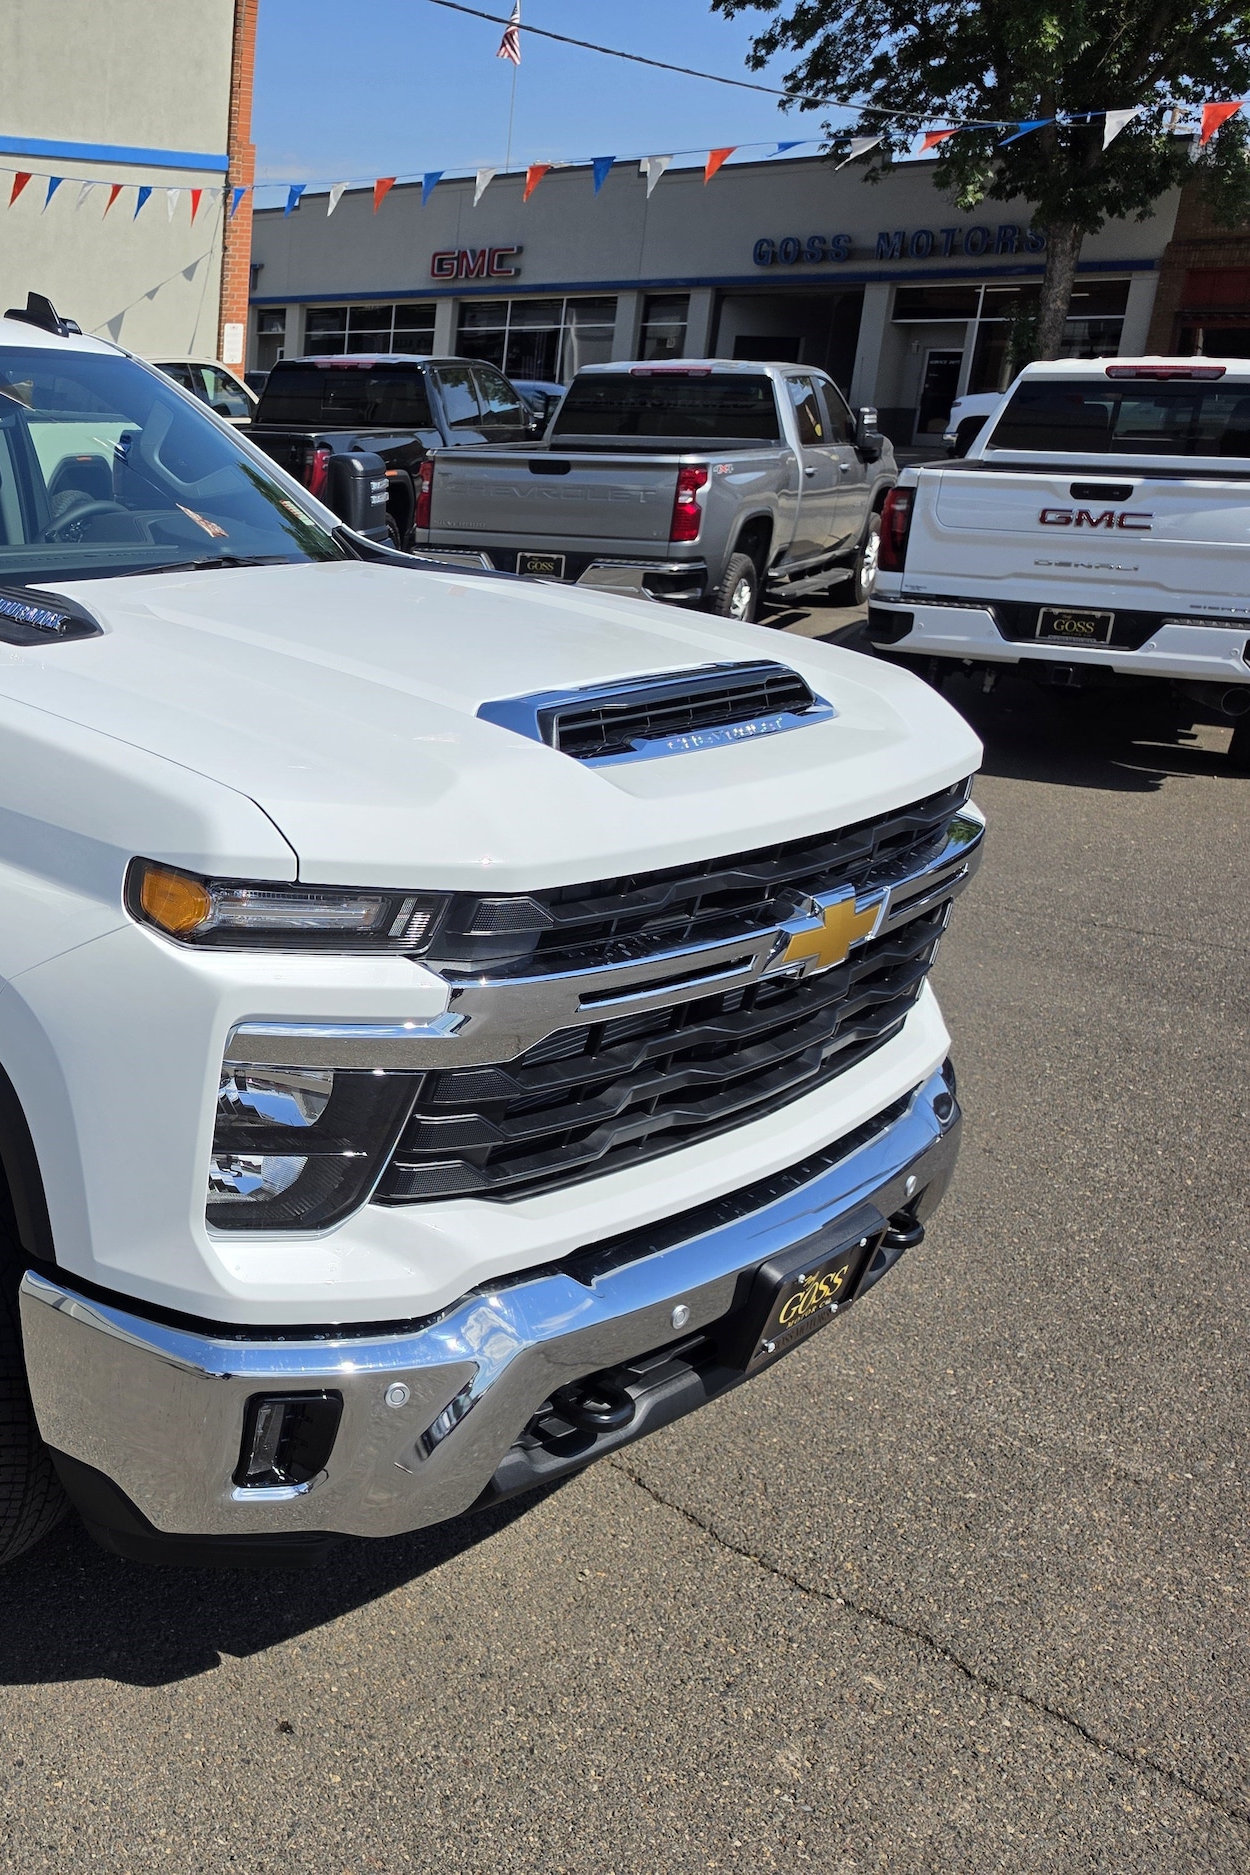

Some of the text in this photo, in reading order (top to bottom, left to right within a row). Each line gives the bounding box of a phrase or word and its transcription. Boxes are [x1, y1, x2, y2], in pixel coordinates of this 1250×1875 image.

[752, 224, 1047, 266] GOSS MOTORS
[430, 246, 519, 279] GMC
[446, 482, 658, 503] CHEVROLET
[1038, 508, 1155, 531] GMC
[526, 561, 555, 571] GOSS
[1034, 560, 1139, 572] DENALI
[1053, 618, 1095, 634] GOSS
[779, 1264, 849, 1324] GOSS
